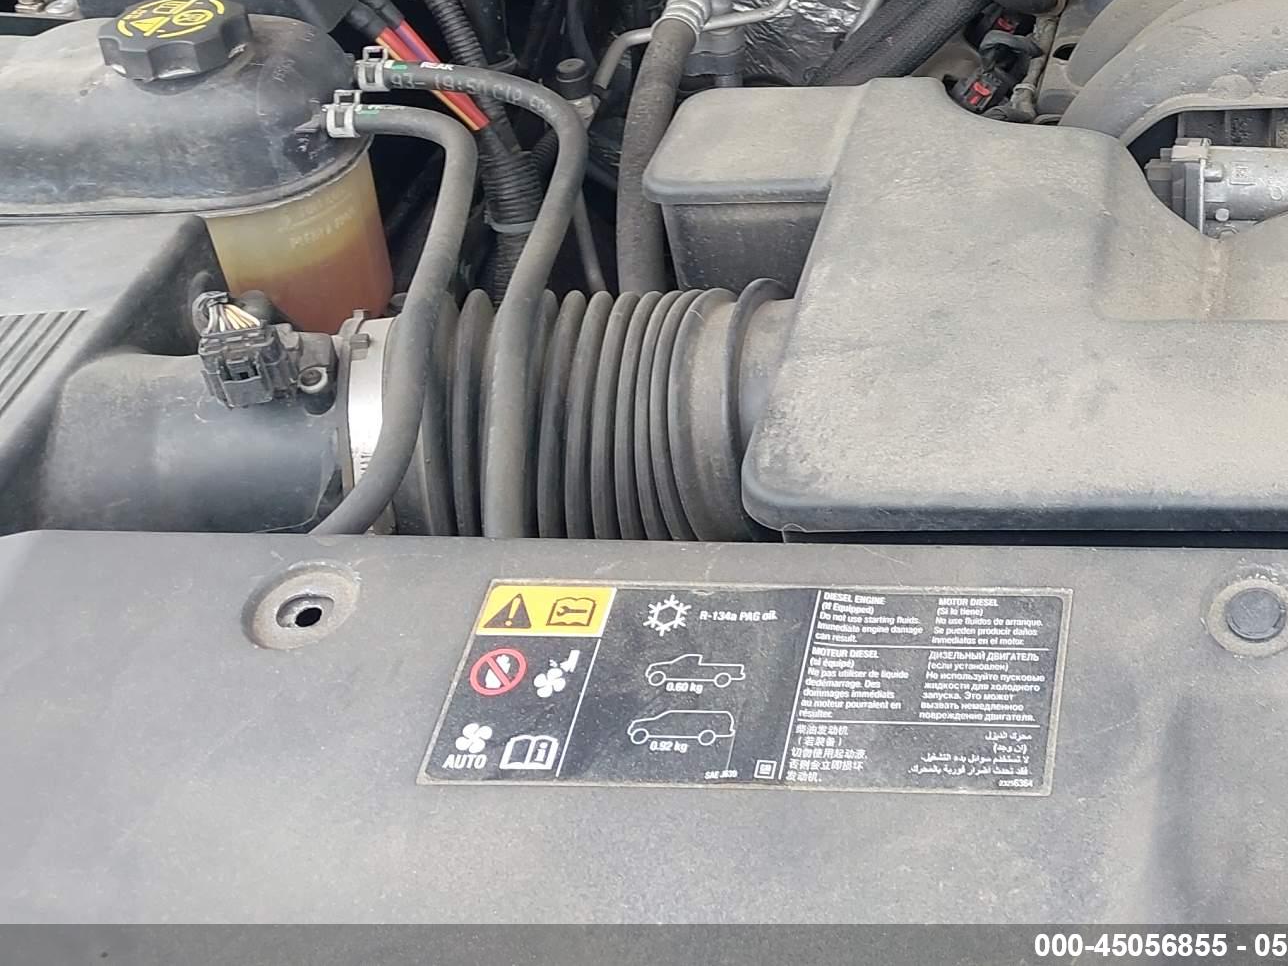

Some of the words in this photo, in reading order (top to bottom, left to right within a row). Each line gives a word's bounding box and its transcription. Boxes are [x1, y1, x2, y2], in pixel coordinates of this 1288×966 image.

[823, 592, 853, 603] DIESEL
[854, 595, 886, 605] ENGINE
[938, 598, 968, 606] MOTOR
[970, 598, 999, 606] DIESEL
[699, 610, 737, 621] R-134a
[739, 611, 760, 621] PAG
[819, 611, 831, 620] Do
[833, 613, 846, 622] not
[847, 615, 862, 623] use
[864, 616, 895, 625] starting
[817, 621, 860, 632] Immediate
[862, 626, 889, 634] engine
[890, 626, 923, 635] damage
[934, 626, 944, 635] Se
[946, 627, 976, 635] pueden
[977, 627, 1011, 636] producir
[812, 647, 848, 657] MOTEUR
[849, 649, 879, 658] DIESEL
[928, 650, 985, 660] ДИЗЕЛЬНЫЙ
[986, 652, 1039, 662] ДВИГАТЕЛЬ
[807, 667, 819, 676] Ne
[880, 670, 909, 679] liquide
[690, 682, 703, 694] kg
[803, 688, 849, 699] dommages
[991, 684, 1040, 692] холодного
[964, 691, 982, 700] Это
[801, 699, 812, 707] au
[813, 700, 844, 708] moteur
[674, 741, 688, 753] kg
[442, 754, 487, 770] AUTO
[704, 770, 720, 779] SAE
